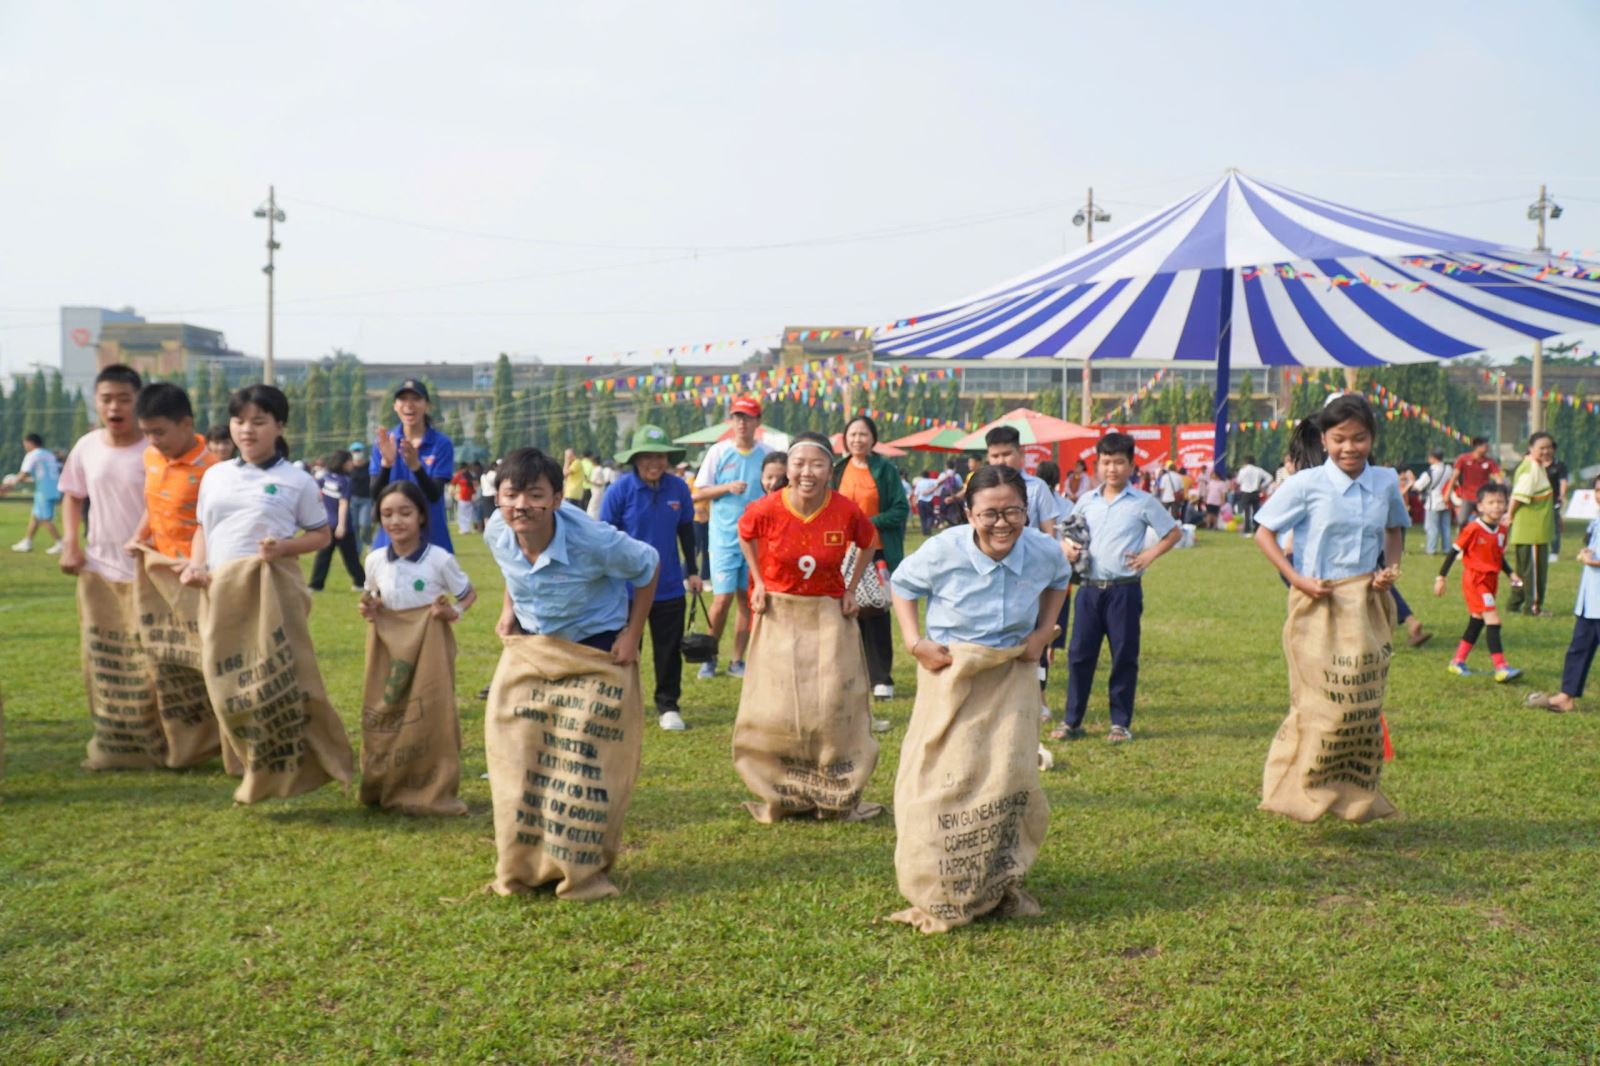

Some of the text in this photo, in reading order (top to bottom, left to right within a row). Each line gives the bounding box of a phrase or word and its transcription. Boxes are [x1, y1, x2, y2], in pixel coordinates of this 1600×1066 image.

[798, 555, 816, 580] 9
[1332, 654, 1353, 668] 166
[1323, 669, 1339, 685] Y3
[1342, 670, 1378, 686] GRADE
[548, 693, 586, 711] GRADE
[550, 798, 567, 815] OF
[937, 812, 959, 830] NEW
[960, 802, 995, 827] GUINEA
[944, 829, 980, 853] COFFEE
